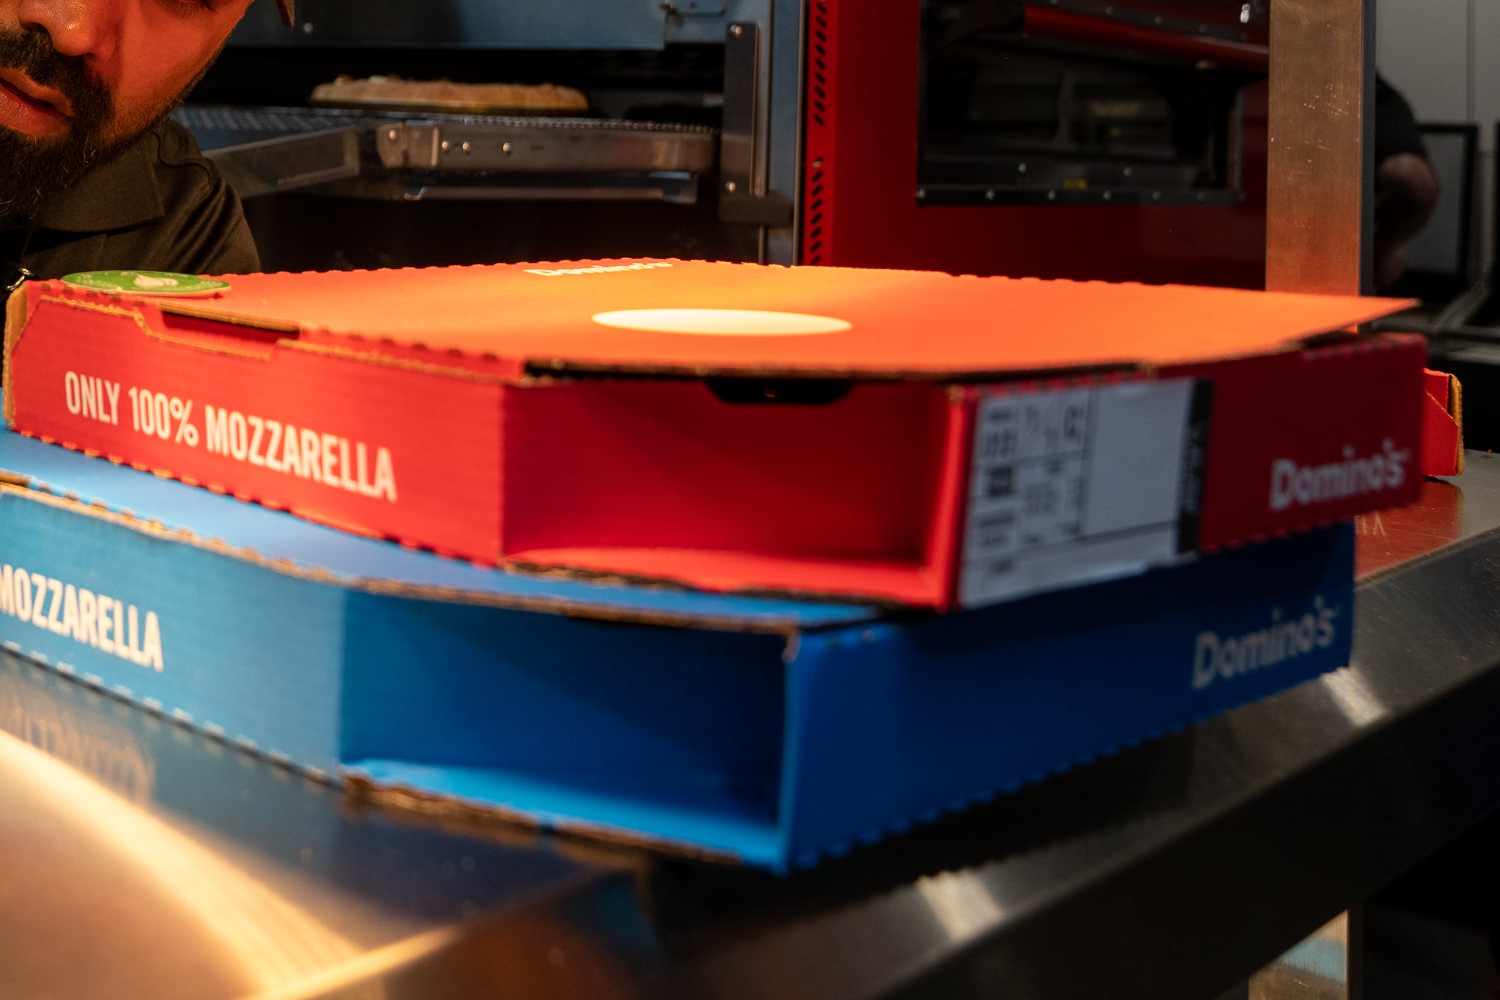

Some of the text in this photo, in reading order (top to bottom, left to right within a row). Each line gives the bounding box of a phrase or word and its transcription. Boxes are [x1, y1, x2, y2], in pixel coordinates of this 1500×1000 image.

[65, 370, 396, 502] ONLY 100% MOZZARELLA
[1269, 439, 1406, 510] Domino's
[1193, 597, 1336, 689] Domino's
